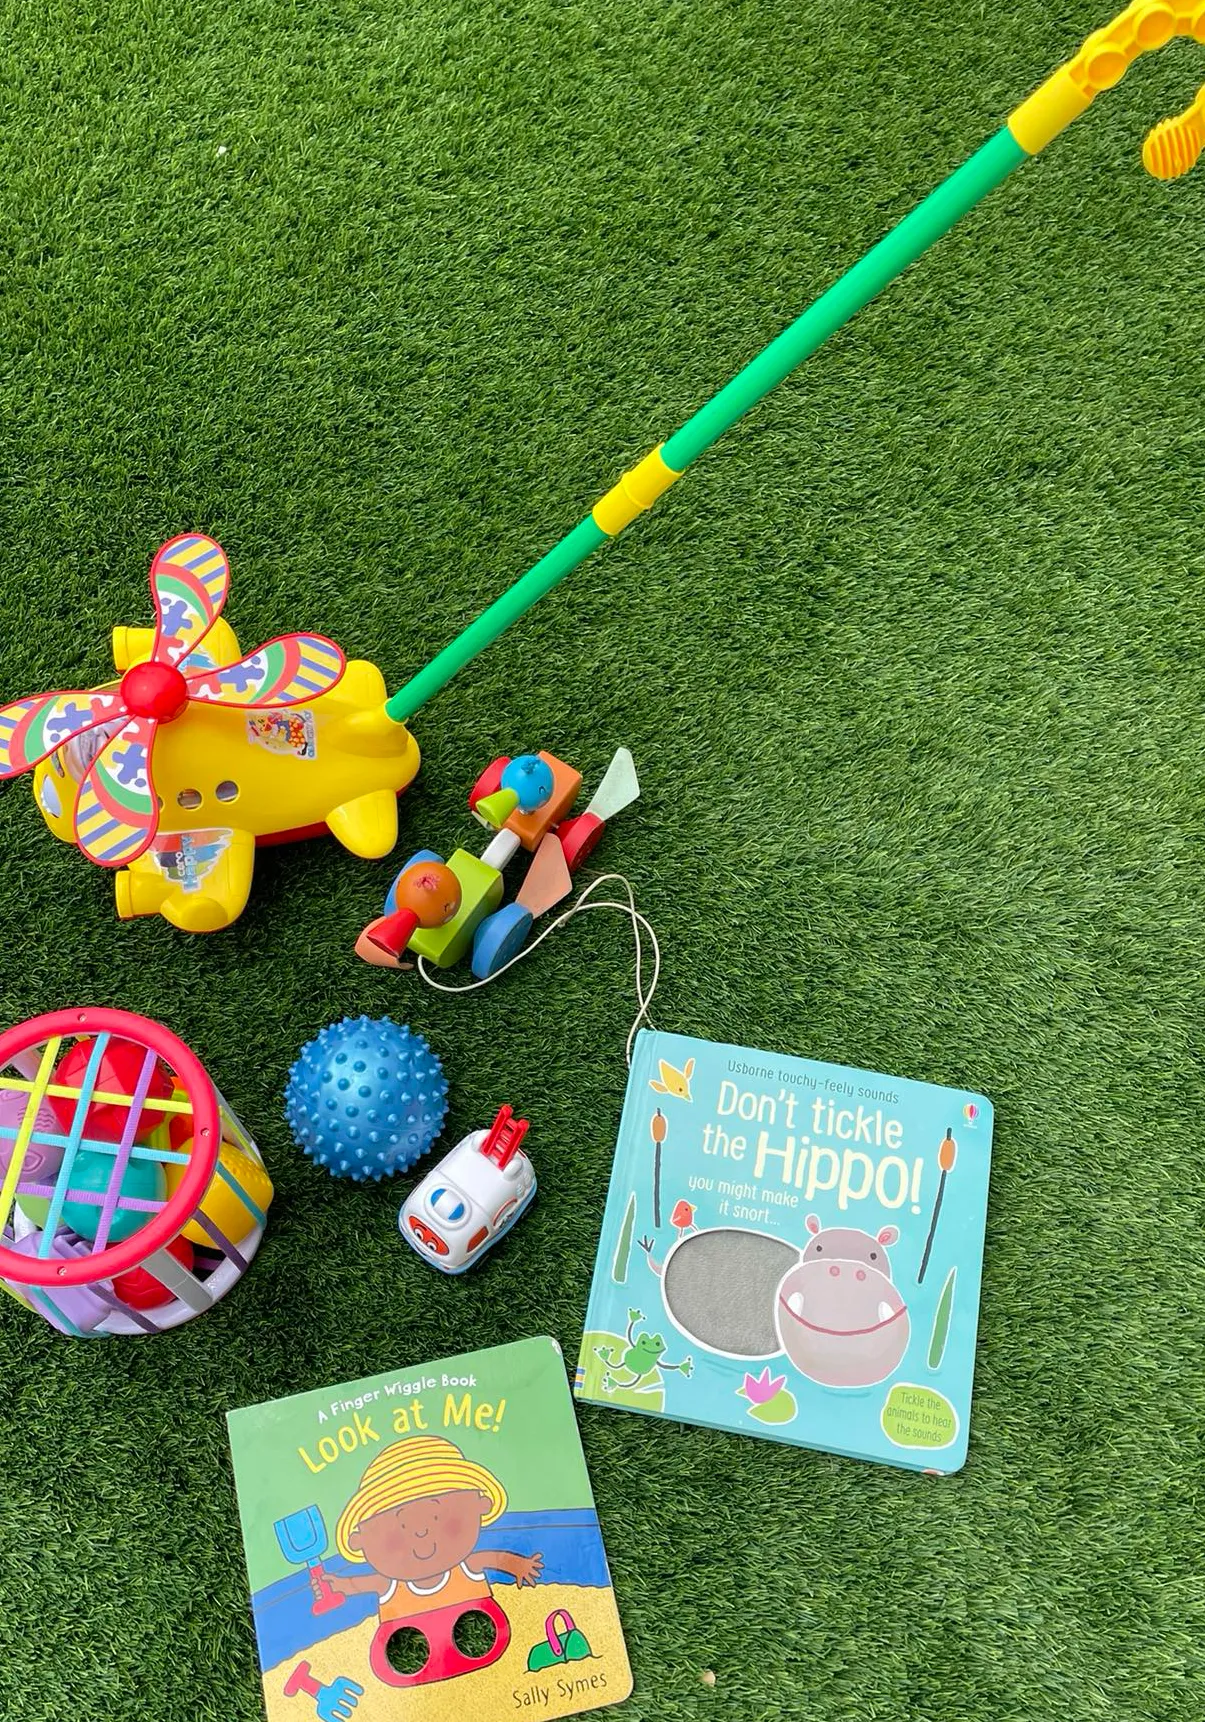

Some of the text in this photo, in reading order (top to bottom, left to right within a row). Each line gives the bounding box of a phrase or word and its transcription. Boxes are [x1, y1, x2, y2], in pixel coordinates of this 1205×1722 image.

[727, 1059, 899, 1104] Usborne touchy-feely sounds
[717, 1080, 904, 1150] Don't tickle
[702, 1123, 924, 1215] the Hippo!
[688, 1175, 799, 1209] you might make
[718, 1198, 781, 1226] it snort...
[317, 1374, 477, 1425] A Finger Wiggle Book
[886, 1406, 952, 1429] animals to hear
[900, 1391, 942, 1411] Tickle the
[297, 1392, 506, 1475] Look at Me!
[896, 1421, 942, 1443] the sounds
[512, 1672, 608, 1709] Sally Symes
